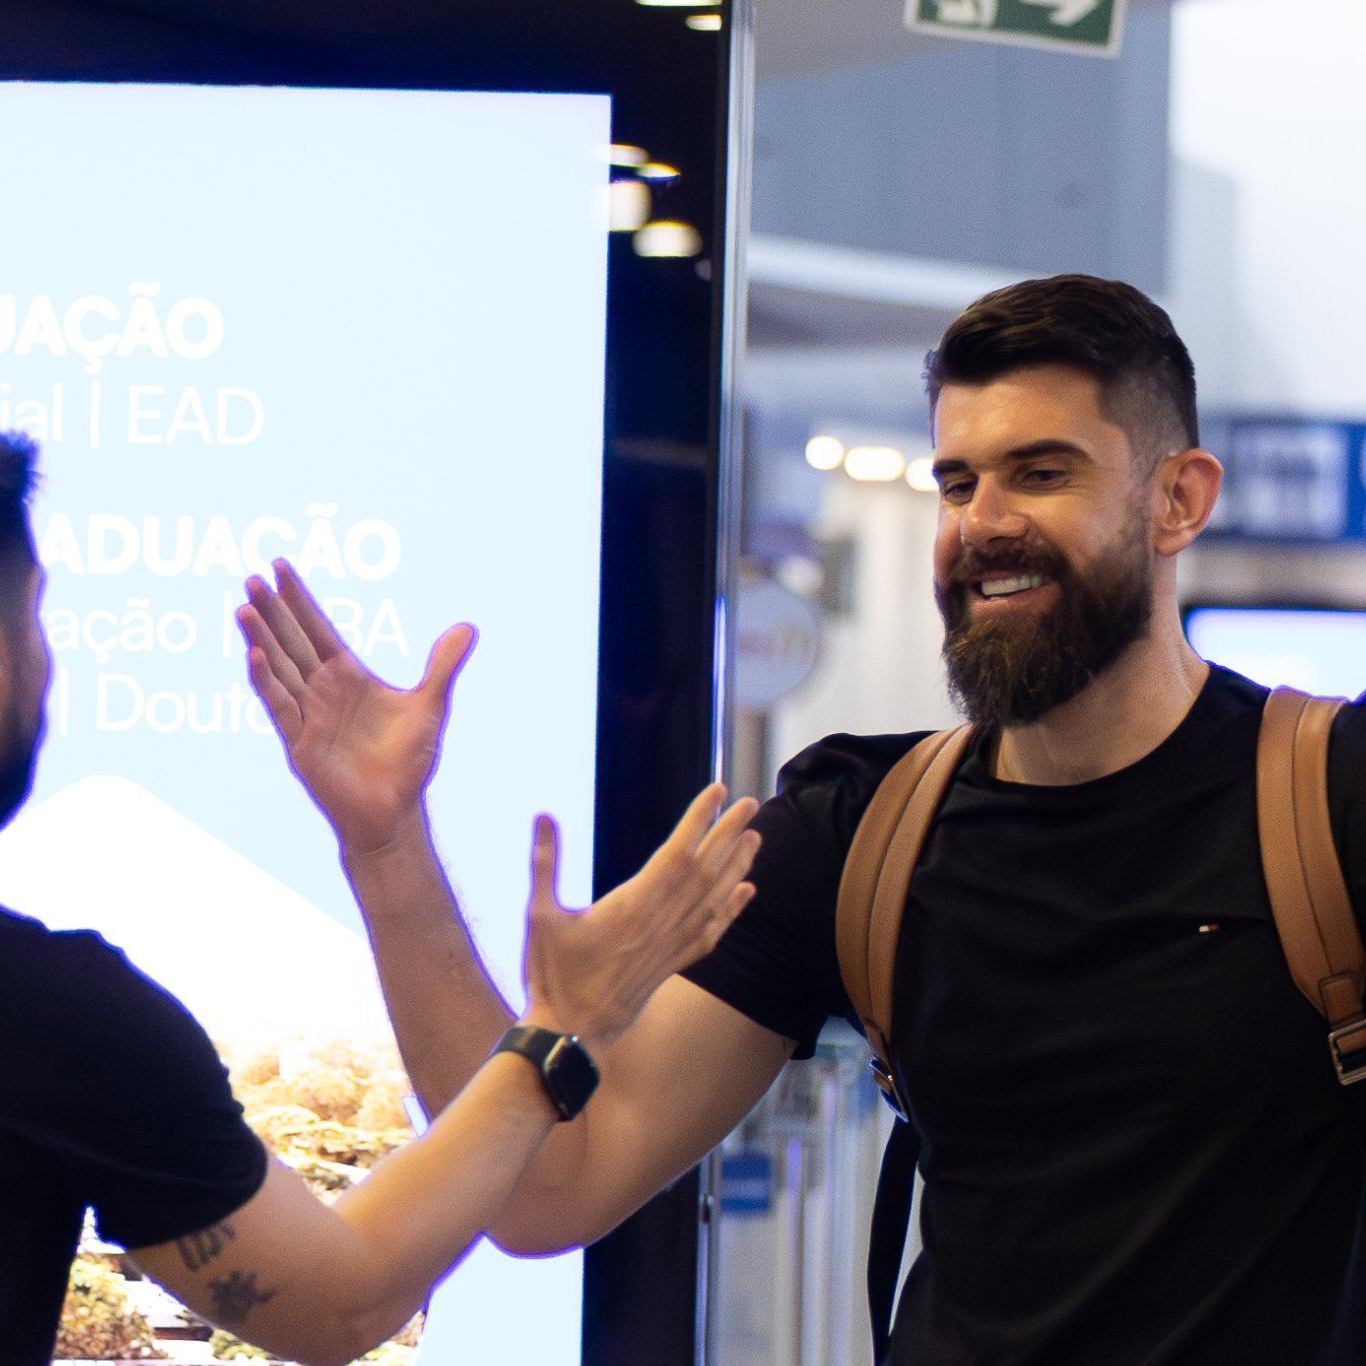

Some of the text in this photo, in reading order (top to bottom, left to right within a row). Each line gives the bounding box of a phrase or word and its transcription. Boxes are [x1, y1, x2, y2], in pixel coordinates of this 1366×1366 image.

[126, 385, 266, 447] EAD
[40, 502, 402, 582] ADUAÇÃO
[322, 597, 411, 657] BA
[96, 672, 276, 736] Douto
